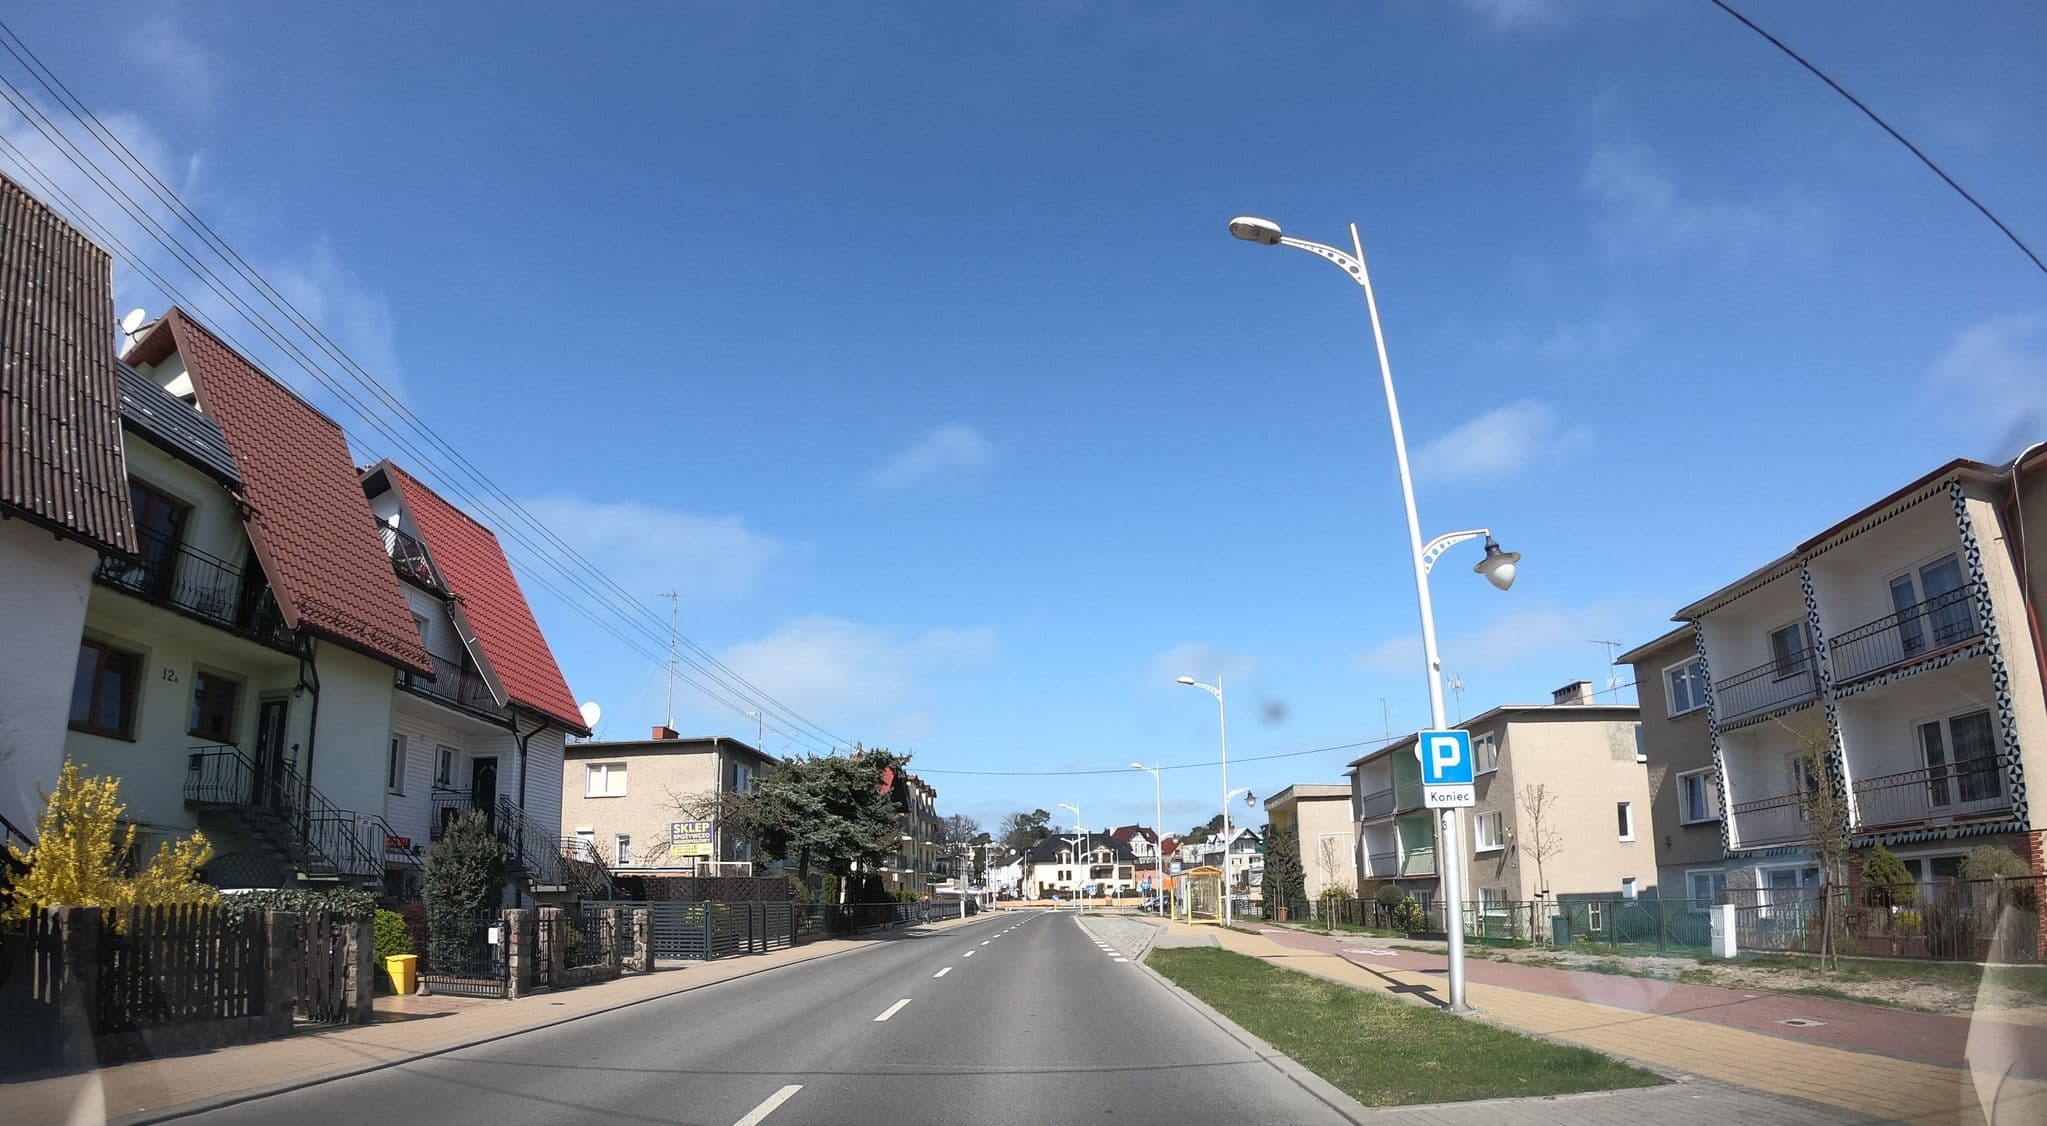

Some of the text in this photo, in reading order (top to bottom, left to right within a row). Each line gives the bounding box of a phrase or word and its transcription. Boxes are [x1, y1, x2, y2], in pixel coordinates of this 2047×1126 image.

[1430, 736, 1461, 779] P
[1430, 791, 1470, 802] Koniec
[673, 822, 710, 834] SKLEP
